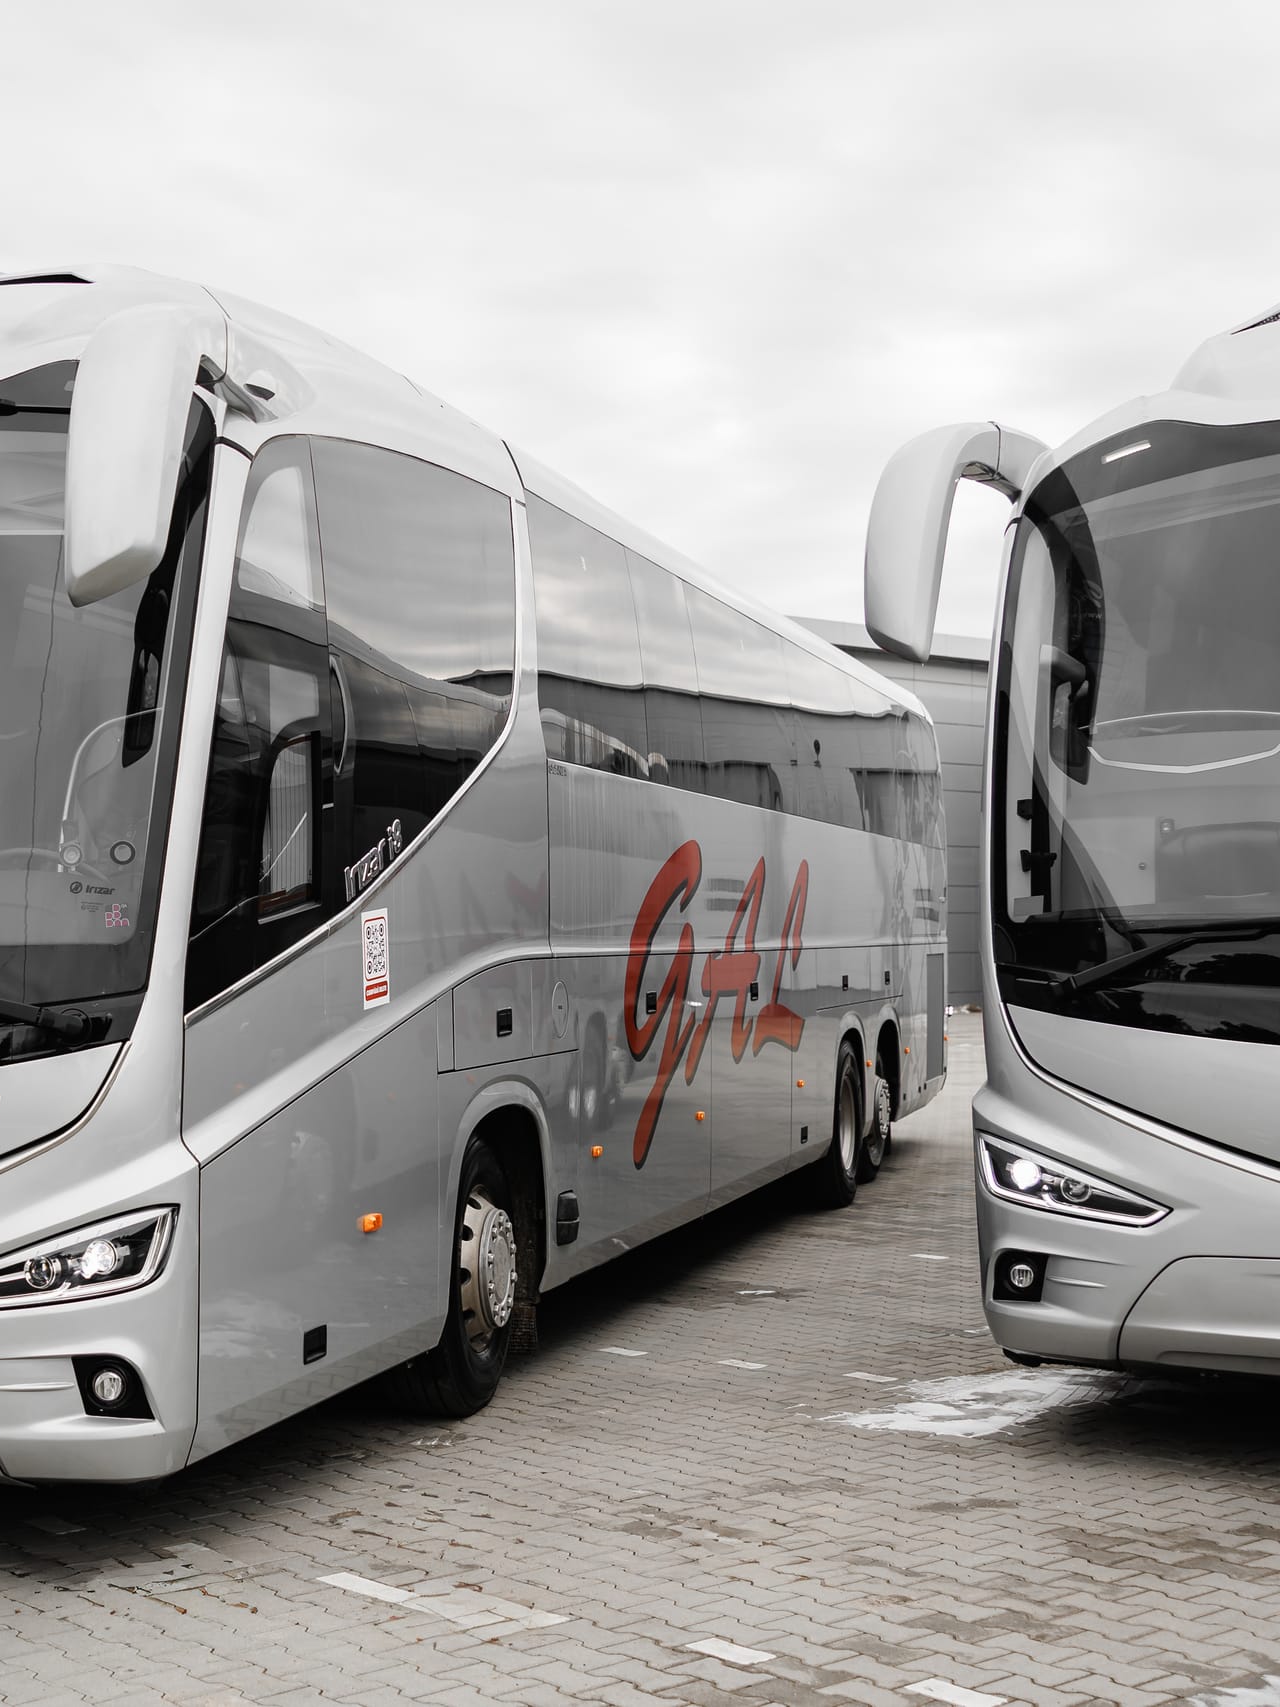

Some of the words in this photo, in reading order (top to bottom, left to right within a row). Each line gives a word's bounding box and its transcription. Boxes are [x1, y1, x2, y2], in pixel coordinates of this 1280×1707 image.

[386, 818, 403, 862] i8
[85, 884, 117, 896] Irizar
[624, 839, 809, 1170] GAL
